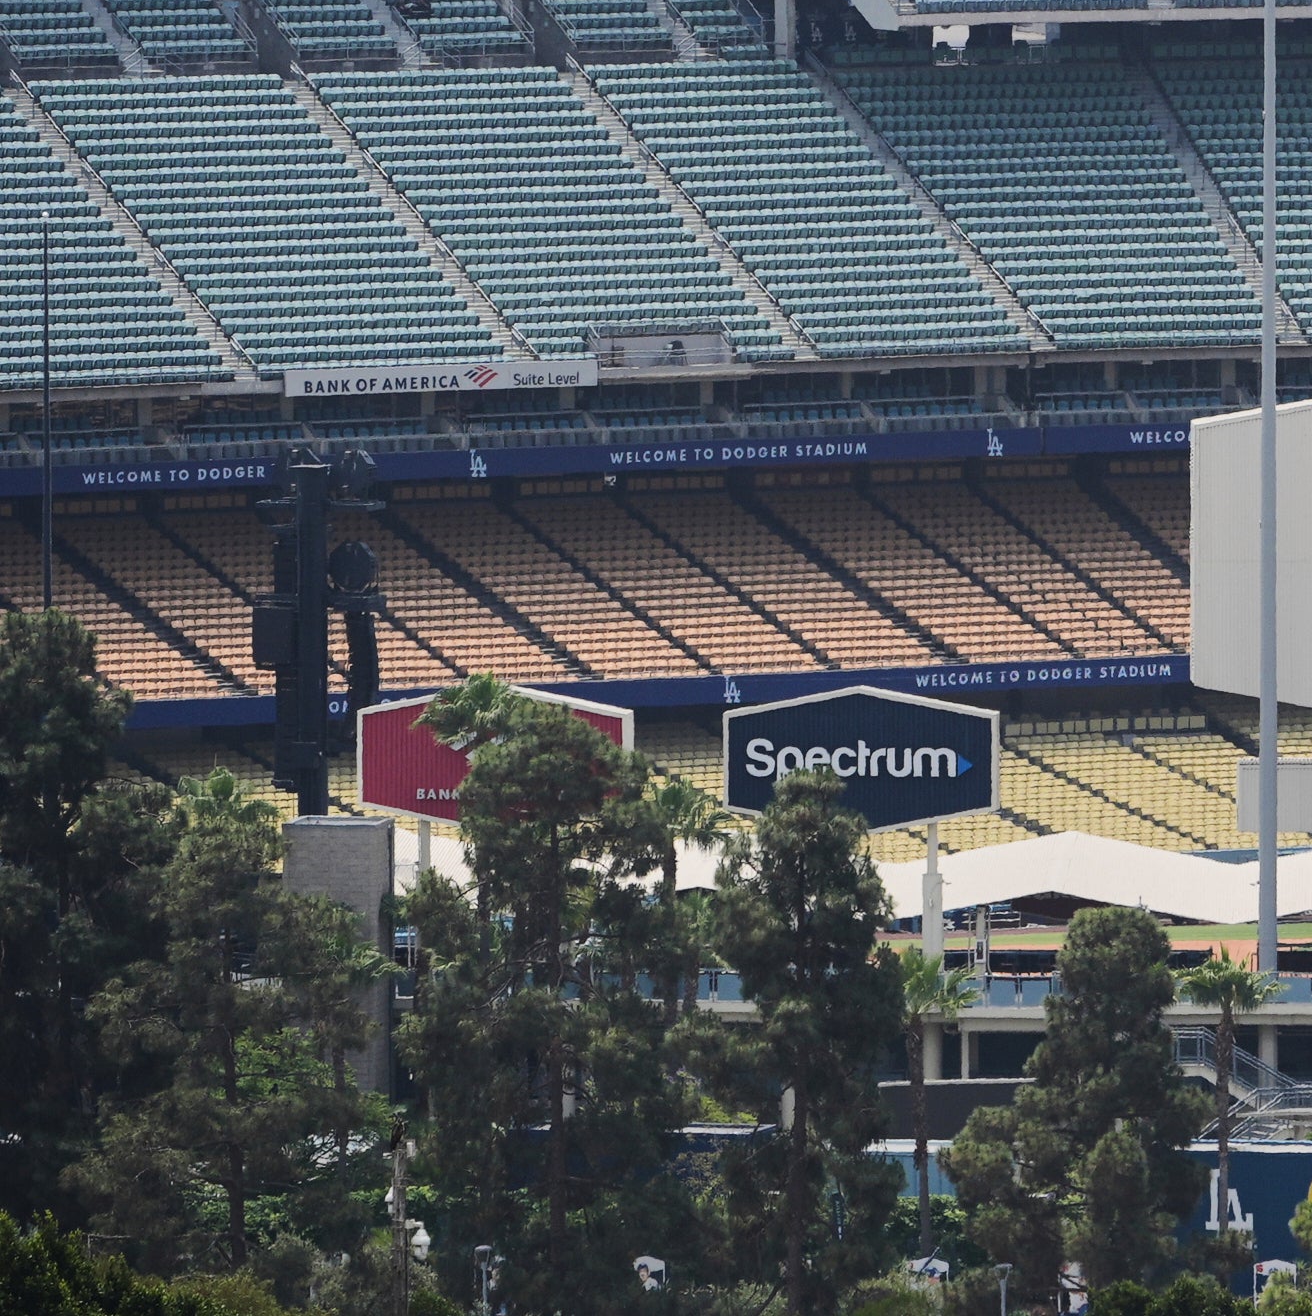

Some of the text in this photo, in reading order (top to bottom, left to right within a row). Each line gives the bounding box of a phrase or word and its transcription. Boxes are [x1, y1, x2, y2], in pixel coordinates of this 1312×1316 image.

[304, 375, 460, 394] BANK OF AMERICA
[513, 371, 580, 386] Suite Level
[986, 427, 1003, 457] LA
[1130, 430, 1192, 444] WELCO
[469, 448, 488, 478] LA
[610, 442, 868, 464] WELCOME TO DODGER STADIUM
[82, 465, 266, 484] WELCOME TO DODGER
[916, 664, 1172, 688] WELCOME TO DODGER STADIUM
[723, 675, 741, 704] LA
[745, 737, 957, 782] Spectrum
[416, 789, 460, 801] BANK
